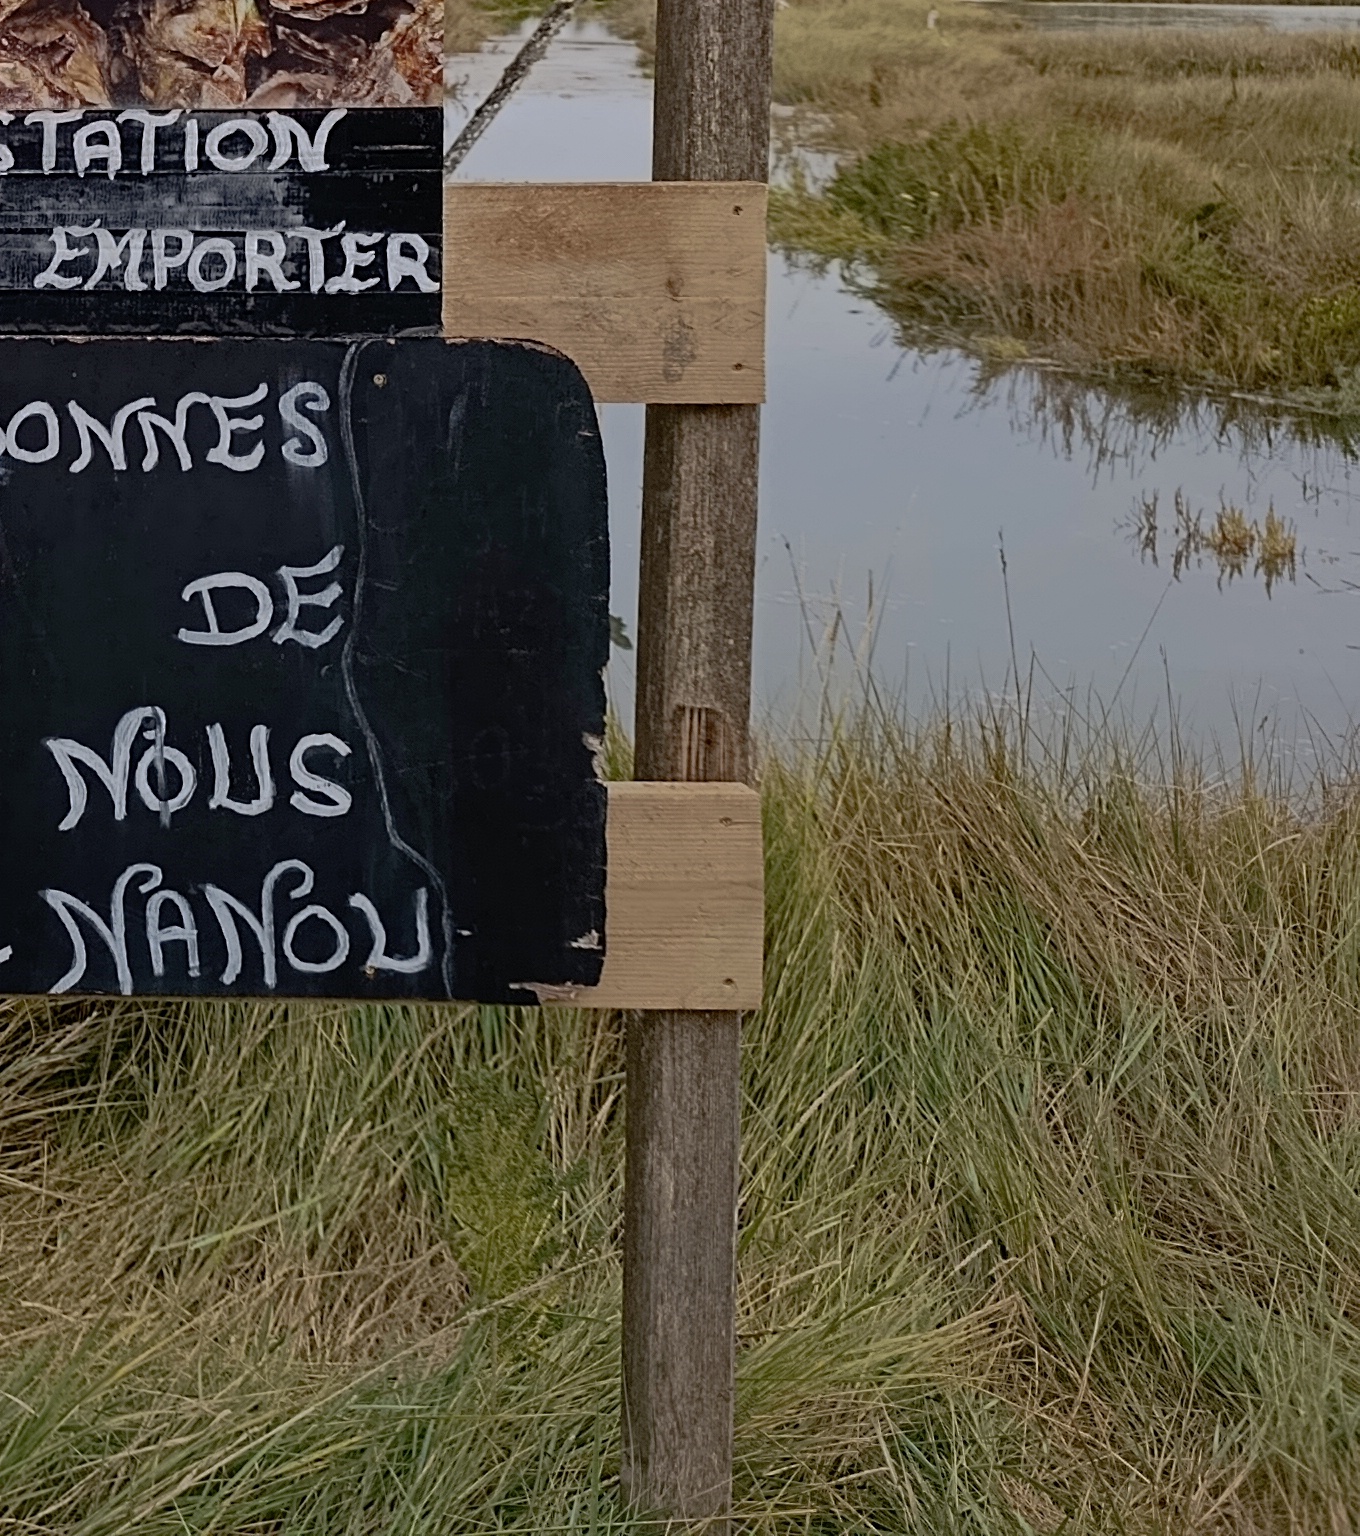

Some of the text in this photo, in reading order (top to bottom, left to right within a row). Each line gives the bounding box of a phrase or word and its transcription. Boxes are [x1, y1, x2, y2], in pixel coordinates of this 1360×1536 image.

[34, 218, 440, 294] EMPORTER
[178, 546, 344, 647] DE
[47, 707, 352, 830] NOUS
[46, 859, 429, 994] NANOU
